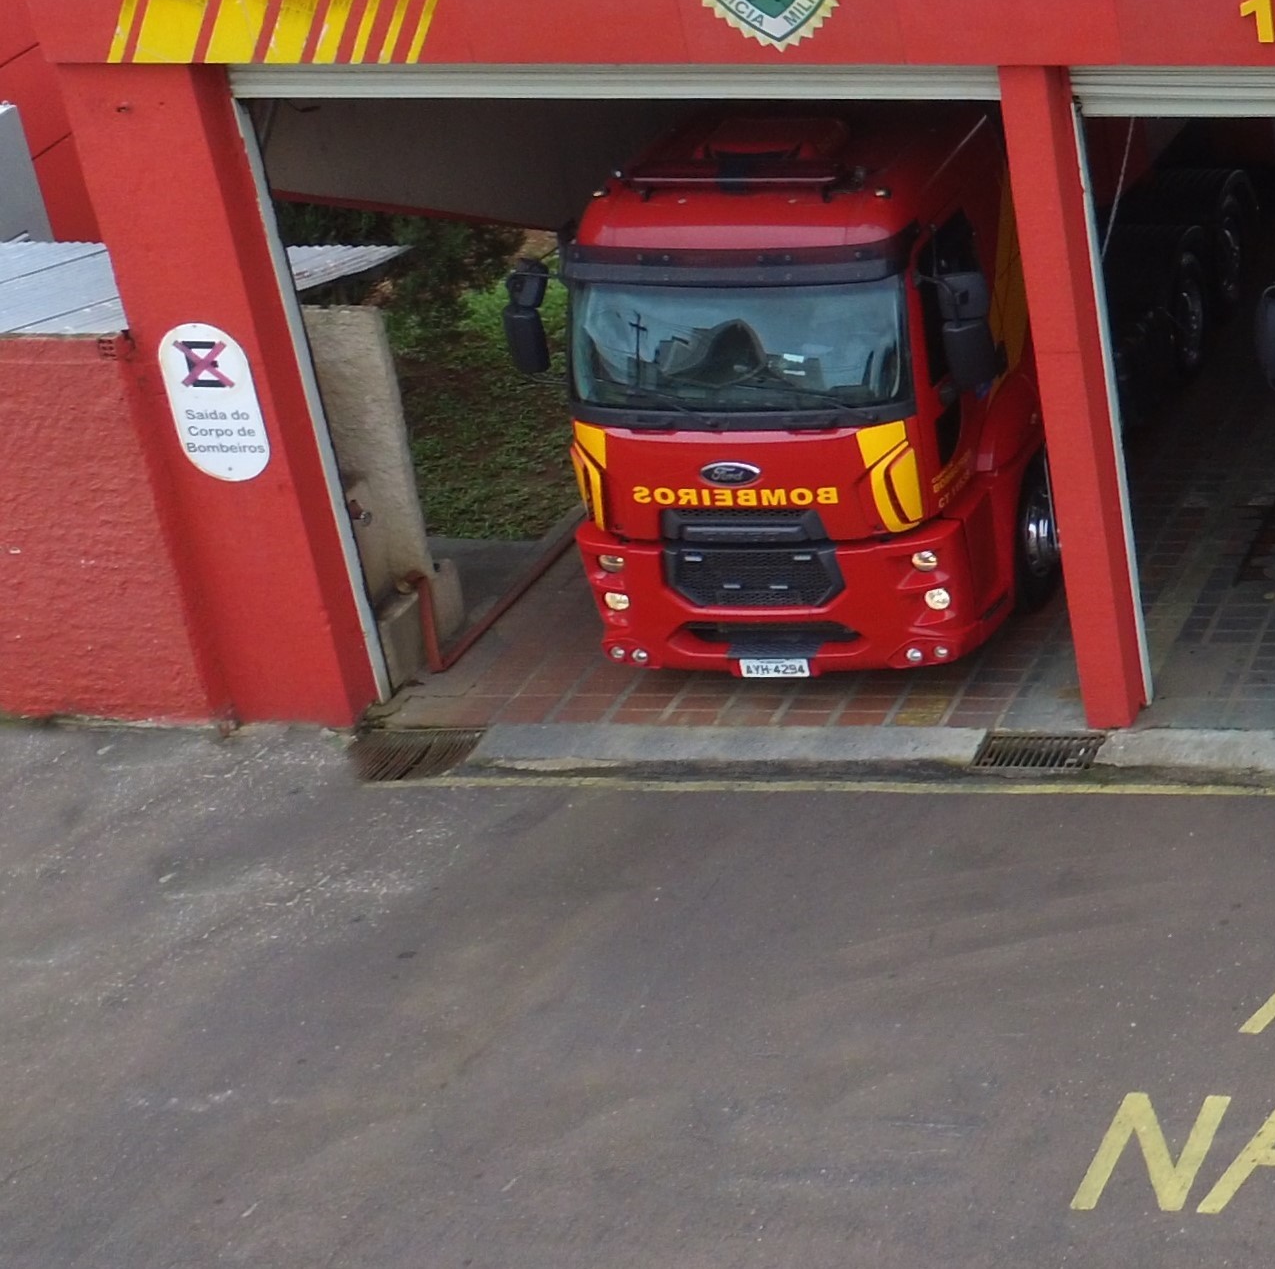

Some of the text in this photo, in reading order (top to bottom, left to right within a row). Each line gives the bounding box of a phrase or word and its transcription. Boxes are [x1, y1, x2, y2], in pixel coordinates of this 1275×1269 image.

[231, 409, 250, 421] do
[188, 425, 256, 438] Corpo de
[186, 442, 266, 454] Bombeiros
[711, 466, 744, 481] Ford
